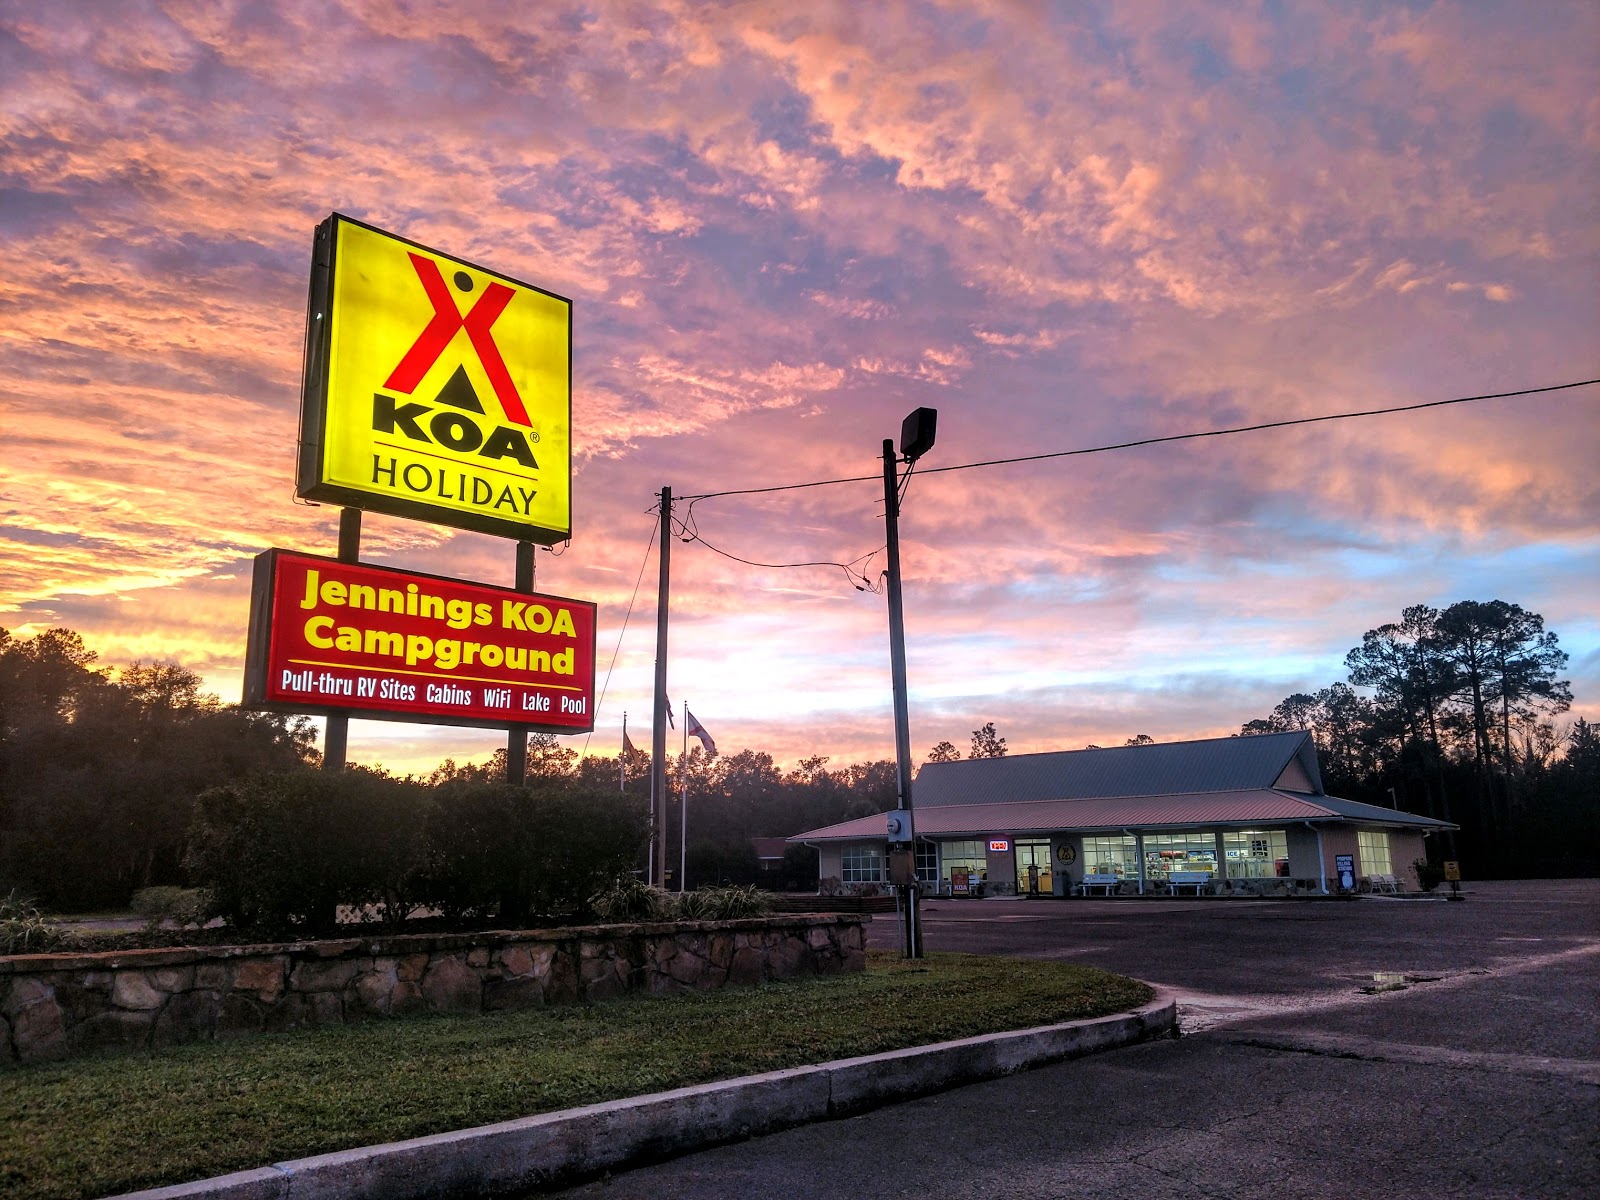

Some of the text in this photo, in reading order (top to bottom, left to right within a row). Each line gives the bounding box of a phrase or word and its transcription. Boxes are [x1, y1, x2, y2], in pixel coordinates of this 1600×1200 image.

[372, 393, 539, 470] KOA
[371, 454, 538, 516] HOLIDAY
[300, 569, 578, 638] Jennings KOA
[303, 616, 575, 676] Campground
[281, 669, 586, 715] Pull-thru RV Sites Cabins WiFi Lake Pool
